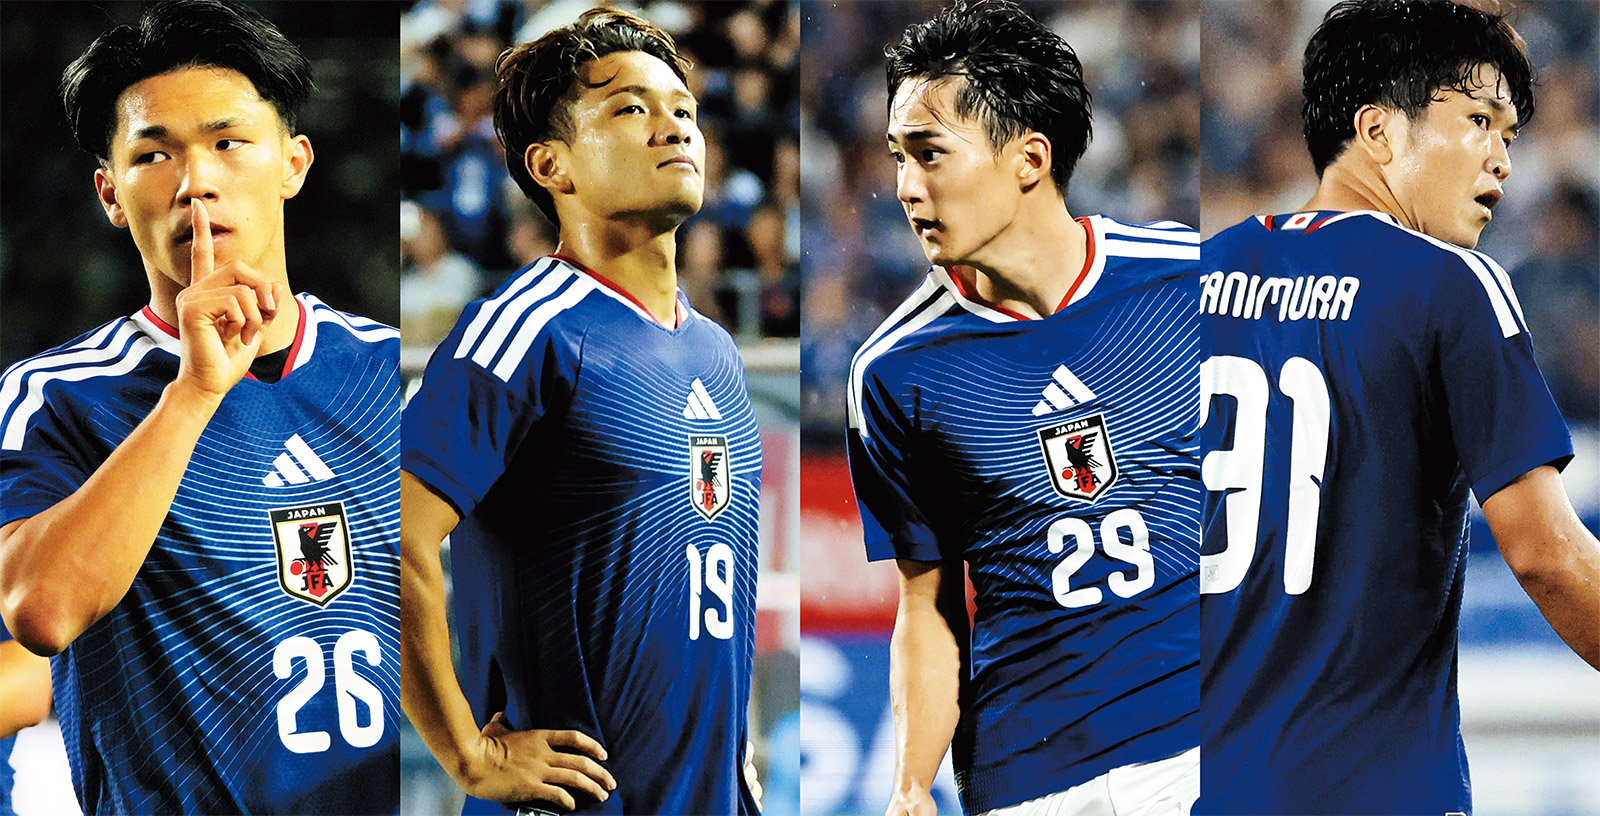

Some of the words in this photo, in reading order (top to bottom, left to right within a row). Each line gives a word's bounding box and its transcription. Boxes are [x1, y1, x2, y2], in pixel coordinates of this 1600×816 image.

[1055, 420, 1089, 436] JAPAN
[696, 437, 718, 446] JAPAN
[1074, 474, 1102, 491] JFA
[1200, 355, 1331, 595] 31
[700, 493, 718, 505] JFA
[287, 507, 326, 520] JAPAN
[1047, 508, 1156, 609] 29
[300, 573, 334, 591] JFA
[686, 542, 734, 641] 19
[273, 629, 385, 754] 26
